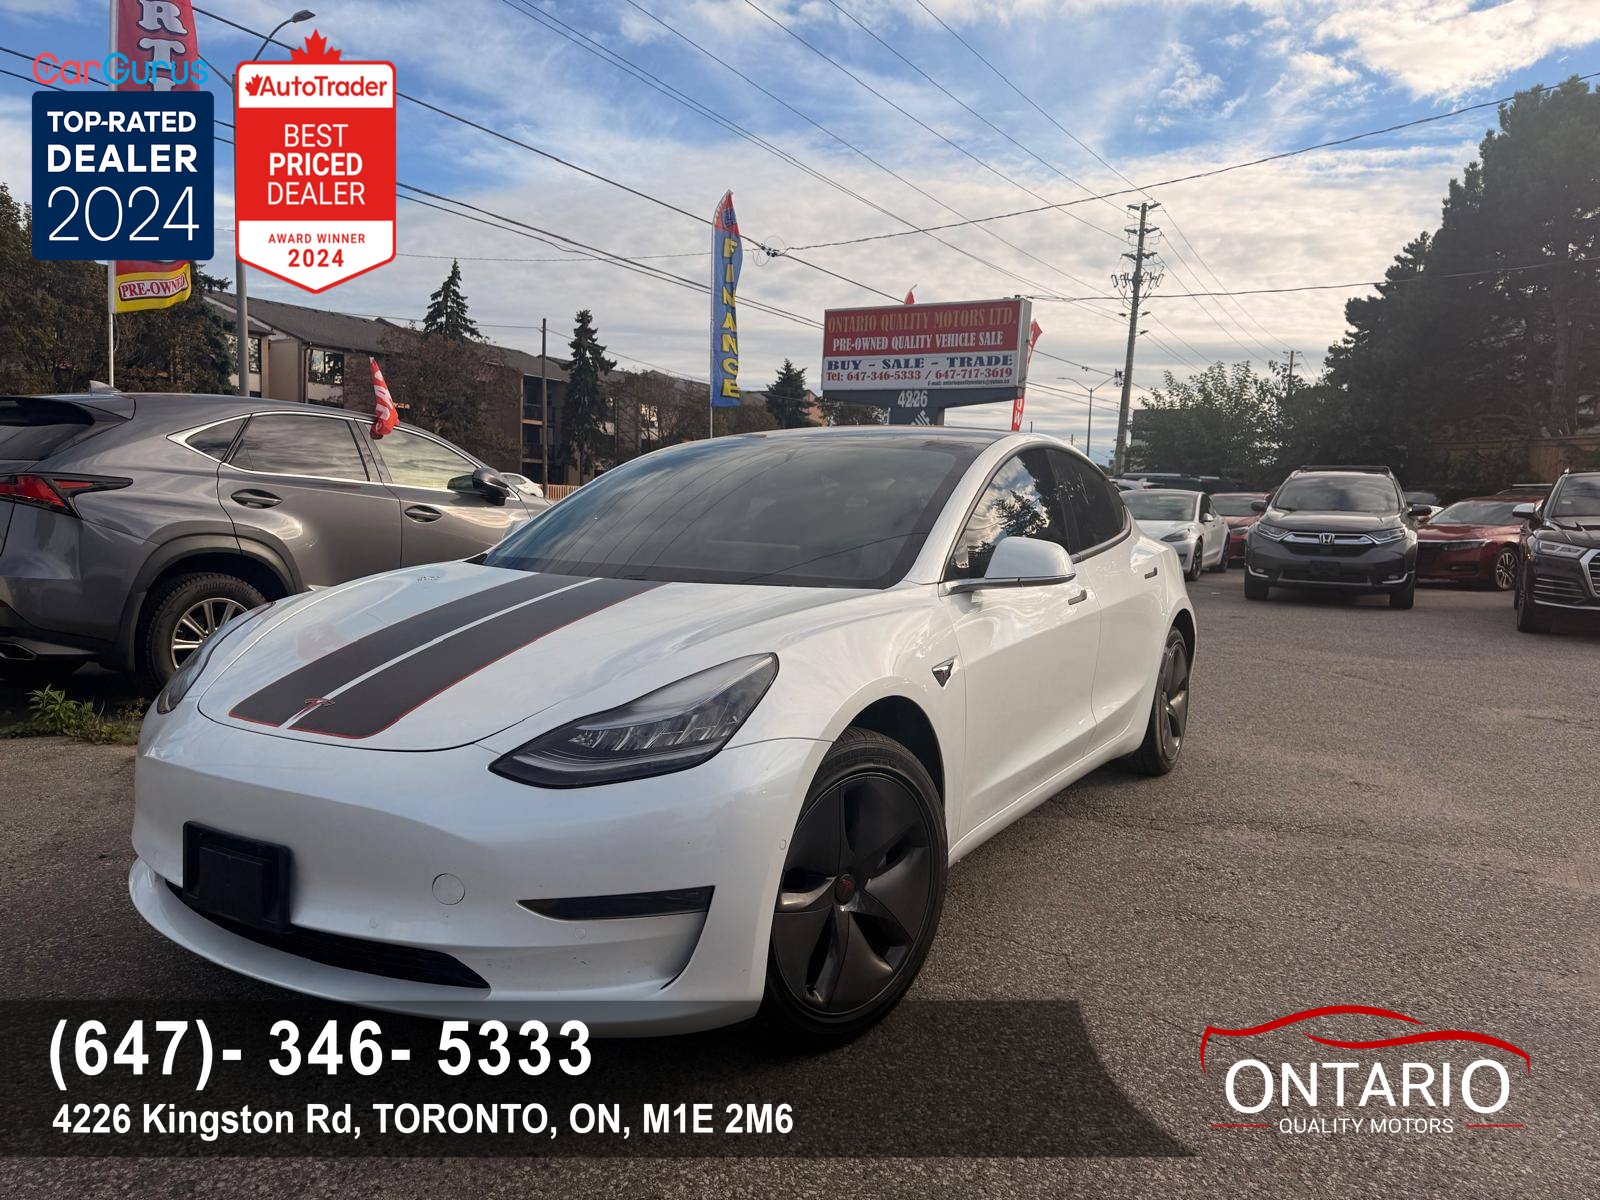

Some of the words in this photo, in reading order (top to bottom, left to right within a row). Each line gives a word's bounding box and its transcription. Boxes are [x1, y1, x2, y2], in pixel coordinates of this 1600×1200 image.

[121, 275, 185, 298] PRE-OWNED
[721, 236, 741, 399] FINANCE
[828, 315, 876, 334] ONTARIO
[881, 312, 930, 331] QUALITY
[935, 309, 985, 328] MOTORS
[989, 307, 1016, 326] LTD.
[832, 335, 888, 351] PRE-OWNED
[891, 333, 932, 350] QUALITY
[935, 331, 976, 348] VEHICLE
[978, 330, 1004, 346] SALE
[827, 360, 862, 371] BUY
[882, 357, 925, 370] SALE
[946, 354, 1013, 368] TRADE
[826, 371, 844, 382] Tel:
[847, 370, 921, 382] 647-346-5333
[935, 367, 1013, 380] 647-717-3619
[897, 390, 928, 408] 4226
